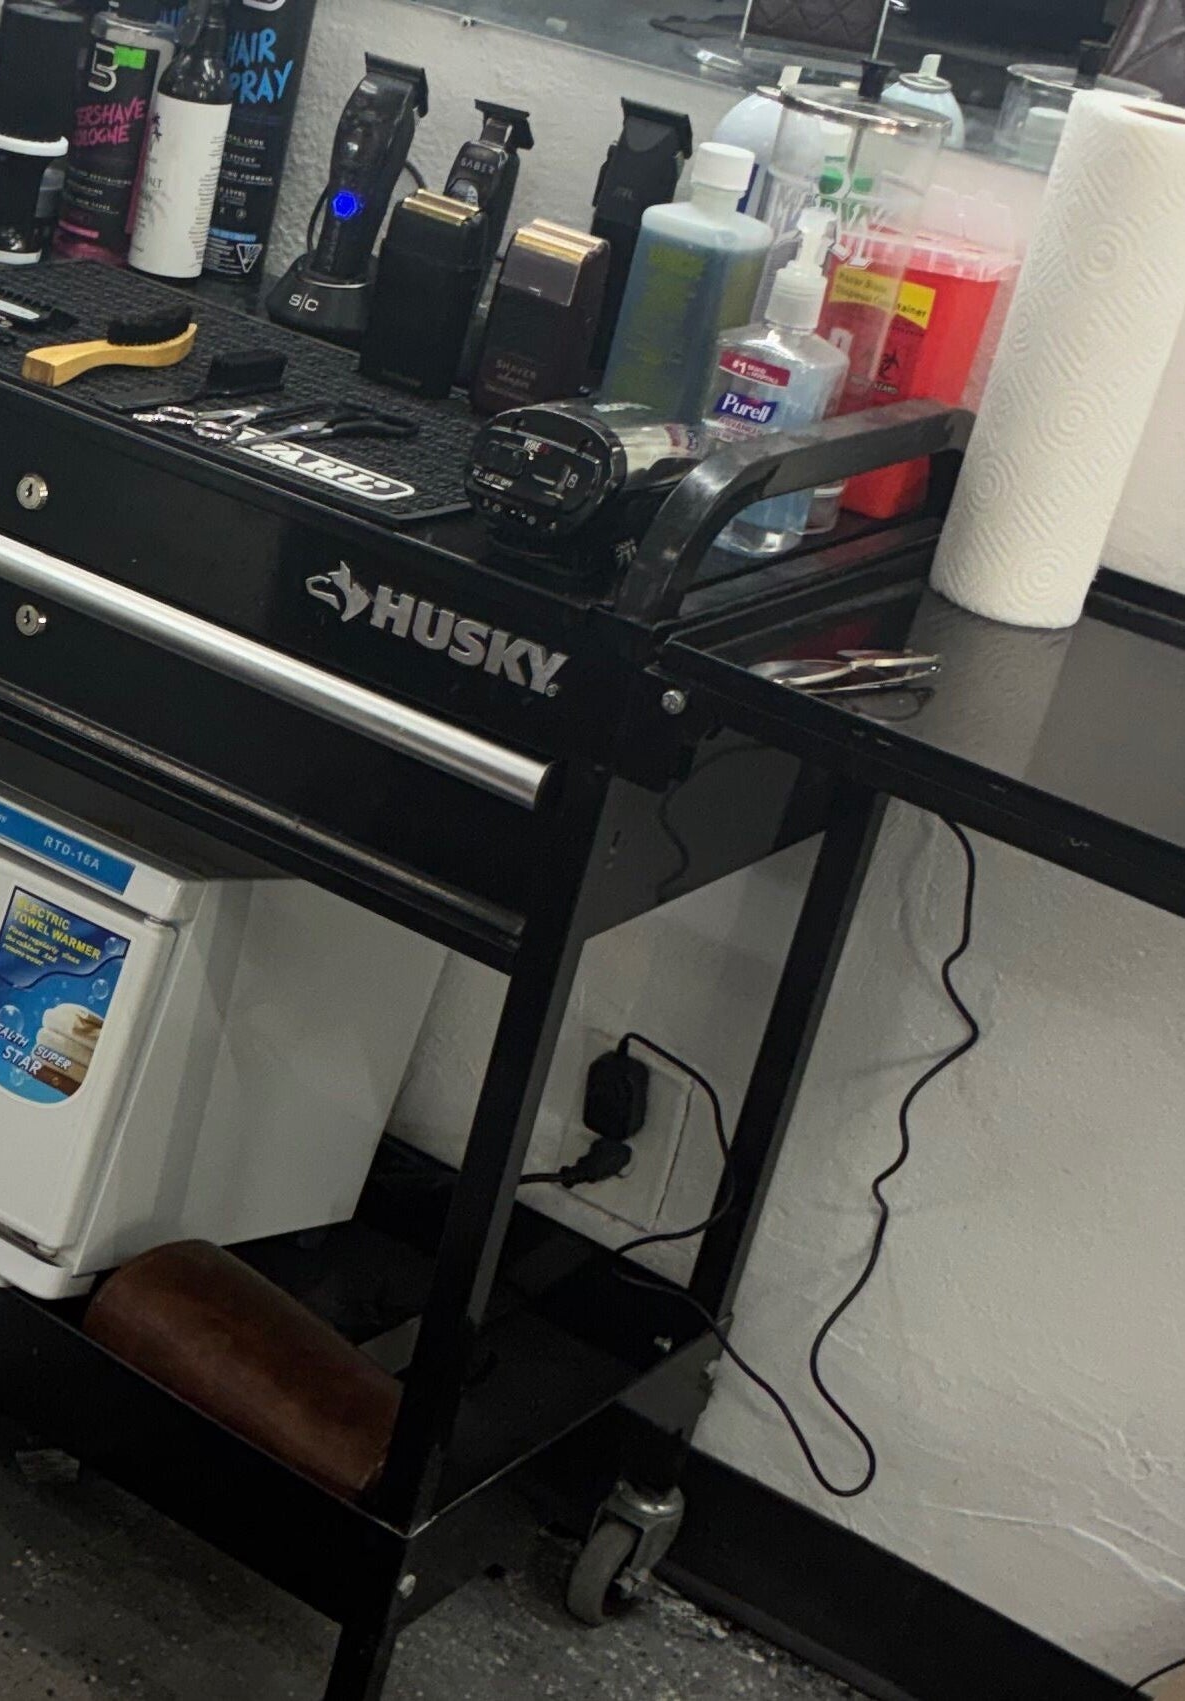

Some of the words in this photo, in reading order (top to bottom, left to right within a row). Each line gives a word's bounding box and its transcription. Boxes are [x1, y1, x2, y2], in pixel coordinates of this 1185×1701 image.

[230, 60, 294, 104] PRAY
[721, 392, 772, 423] Purell
[370, 584, 571, 696] HUSKY
[43, 835, 101, 872] RTD-16A
[16, 896, 71, 931] ELECTRIC
[14, 911, 50, 937] TOWEL
[52, 928, 102, 961] WARMER
[2, 1045, 44, 1076] STAR
[35, 1045, 73, 1070] SUPER
